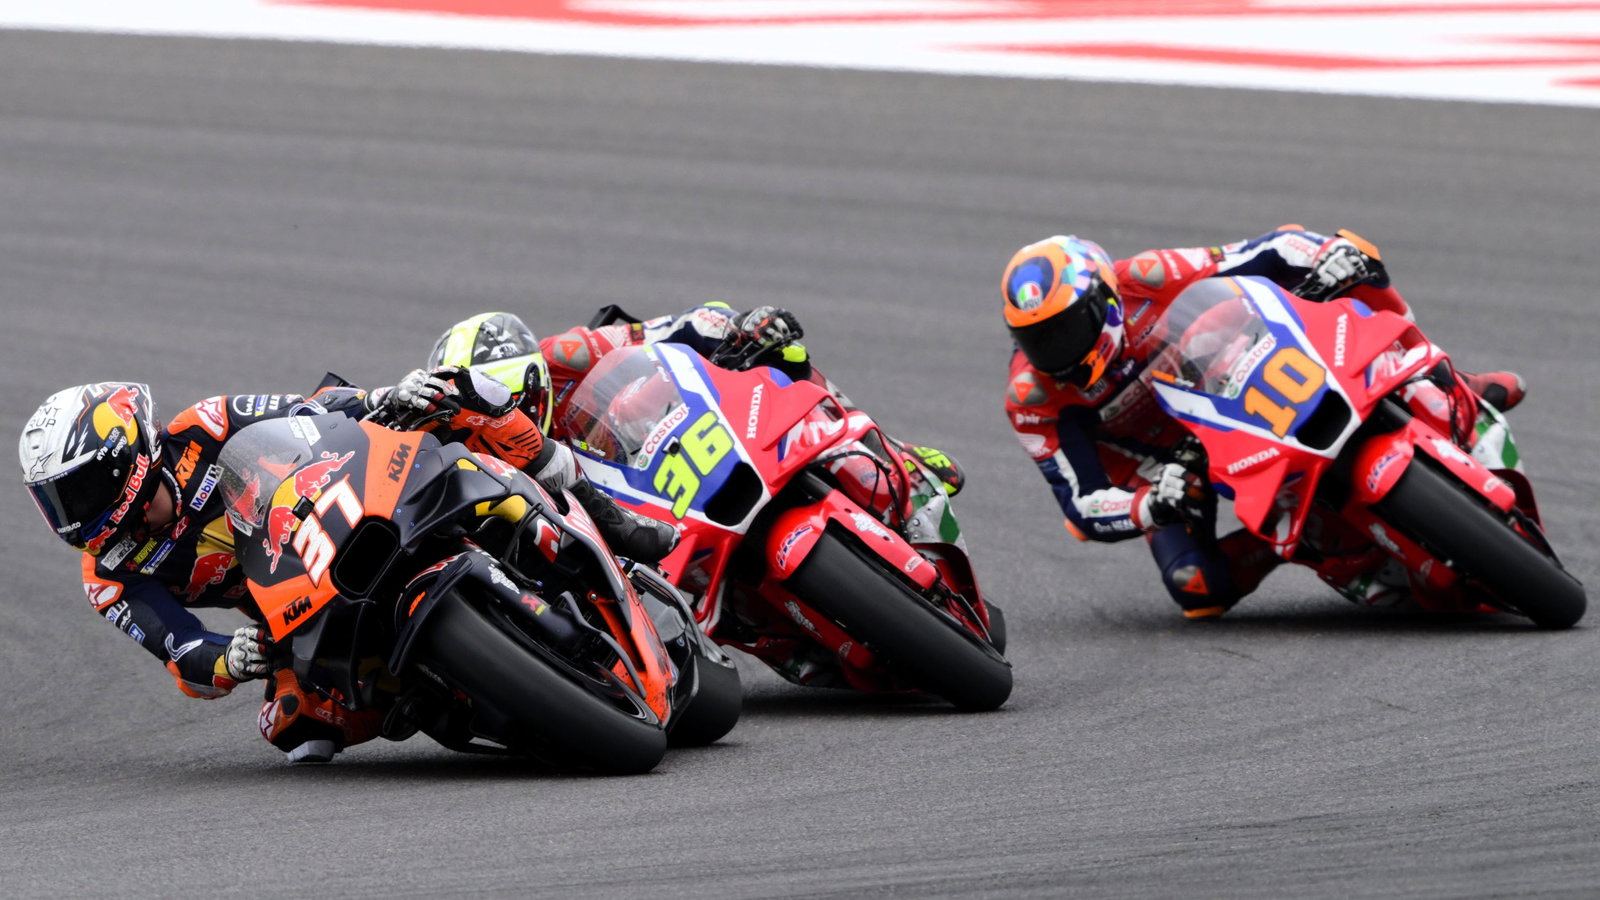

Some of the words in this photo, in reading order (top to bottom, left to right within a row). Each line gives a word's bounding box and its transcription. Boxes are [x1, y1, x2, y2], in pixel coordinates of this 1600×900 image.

[1236, 334, 1276, 383] Castrol
[1334, 313, 1348, 367] HONDA
[746, 383, 764, 440] HONDA
[1244, 347, 1326, 439] 10
[645, 406, 688, 455] Castrol
[174, 440, 203, 489] KTM
[387, 443, 412, 483] KTM
[653, 410, 735, 521] 36
[1227, 447, 1280, 475] HONDA
[109, 488, 137, 525] Red
[130, 453, 150, 492] Bull
[192, 478, 216, 509] Mobil
[292, 473, 365, 589] 37
[282, 596, 313, 626] KTM
